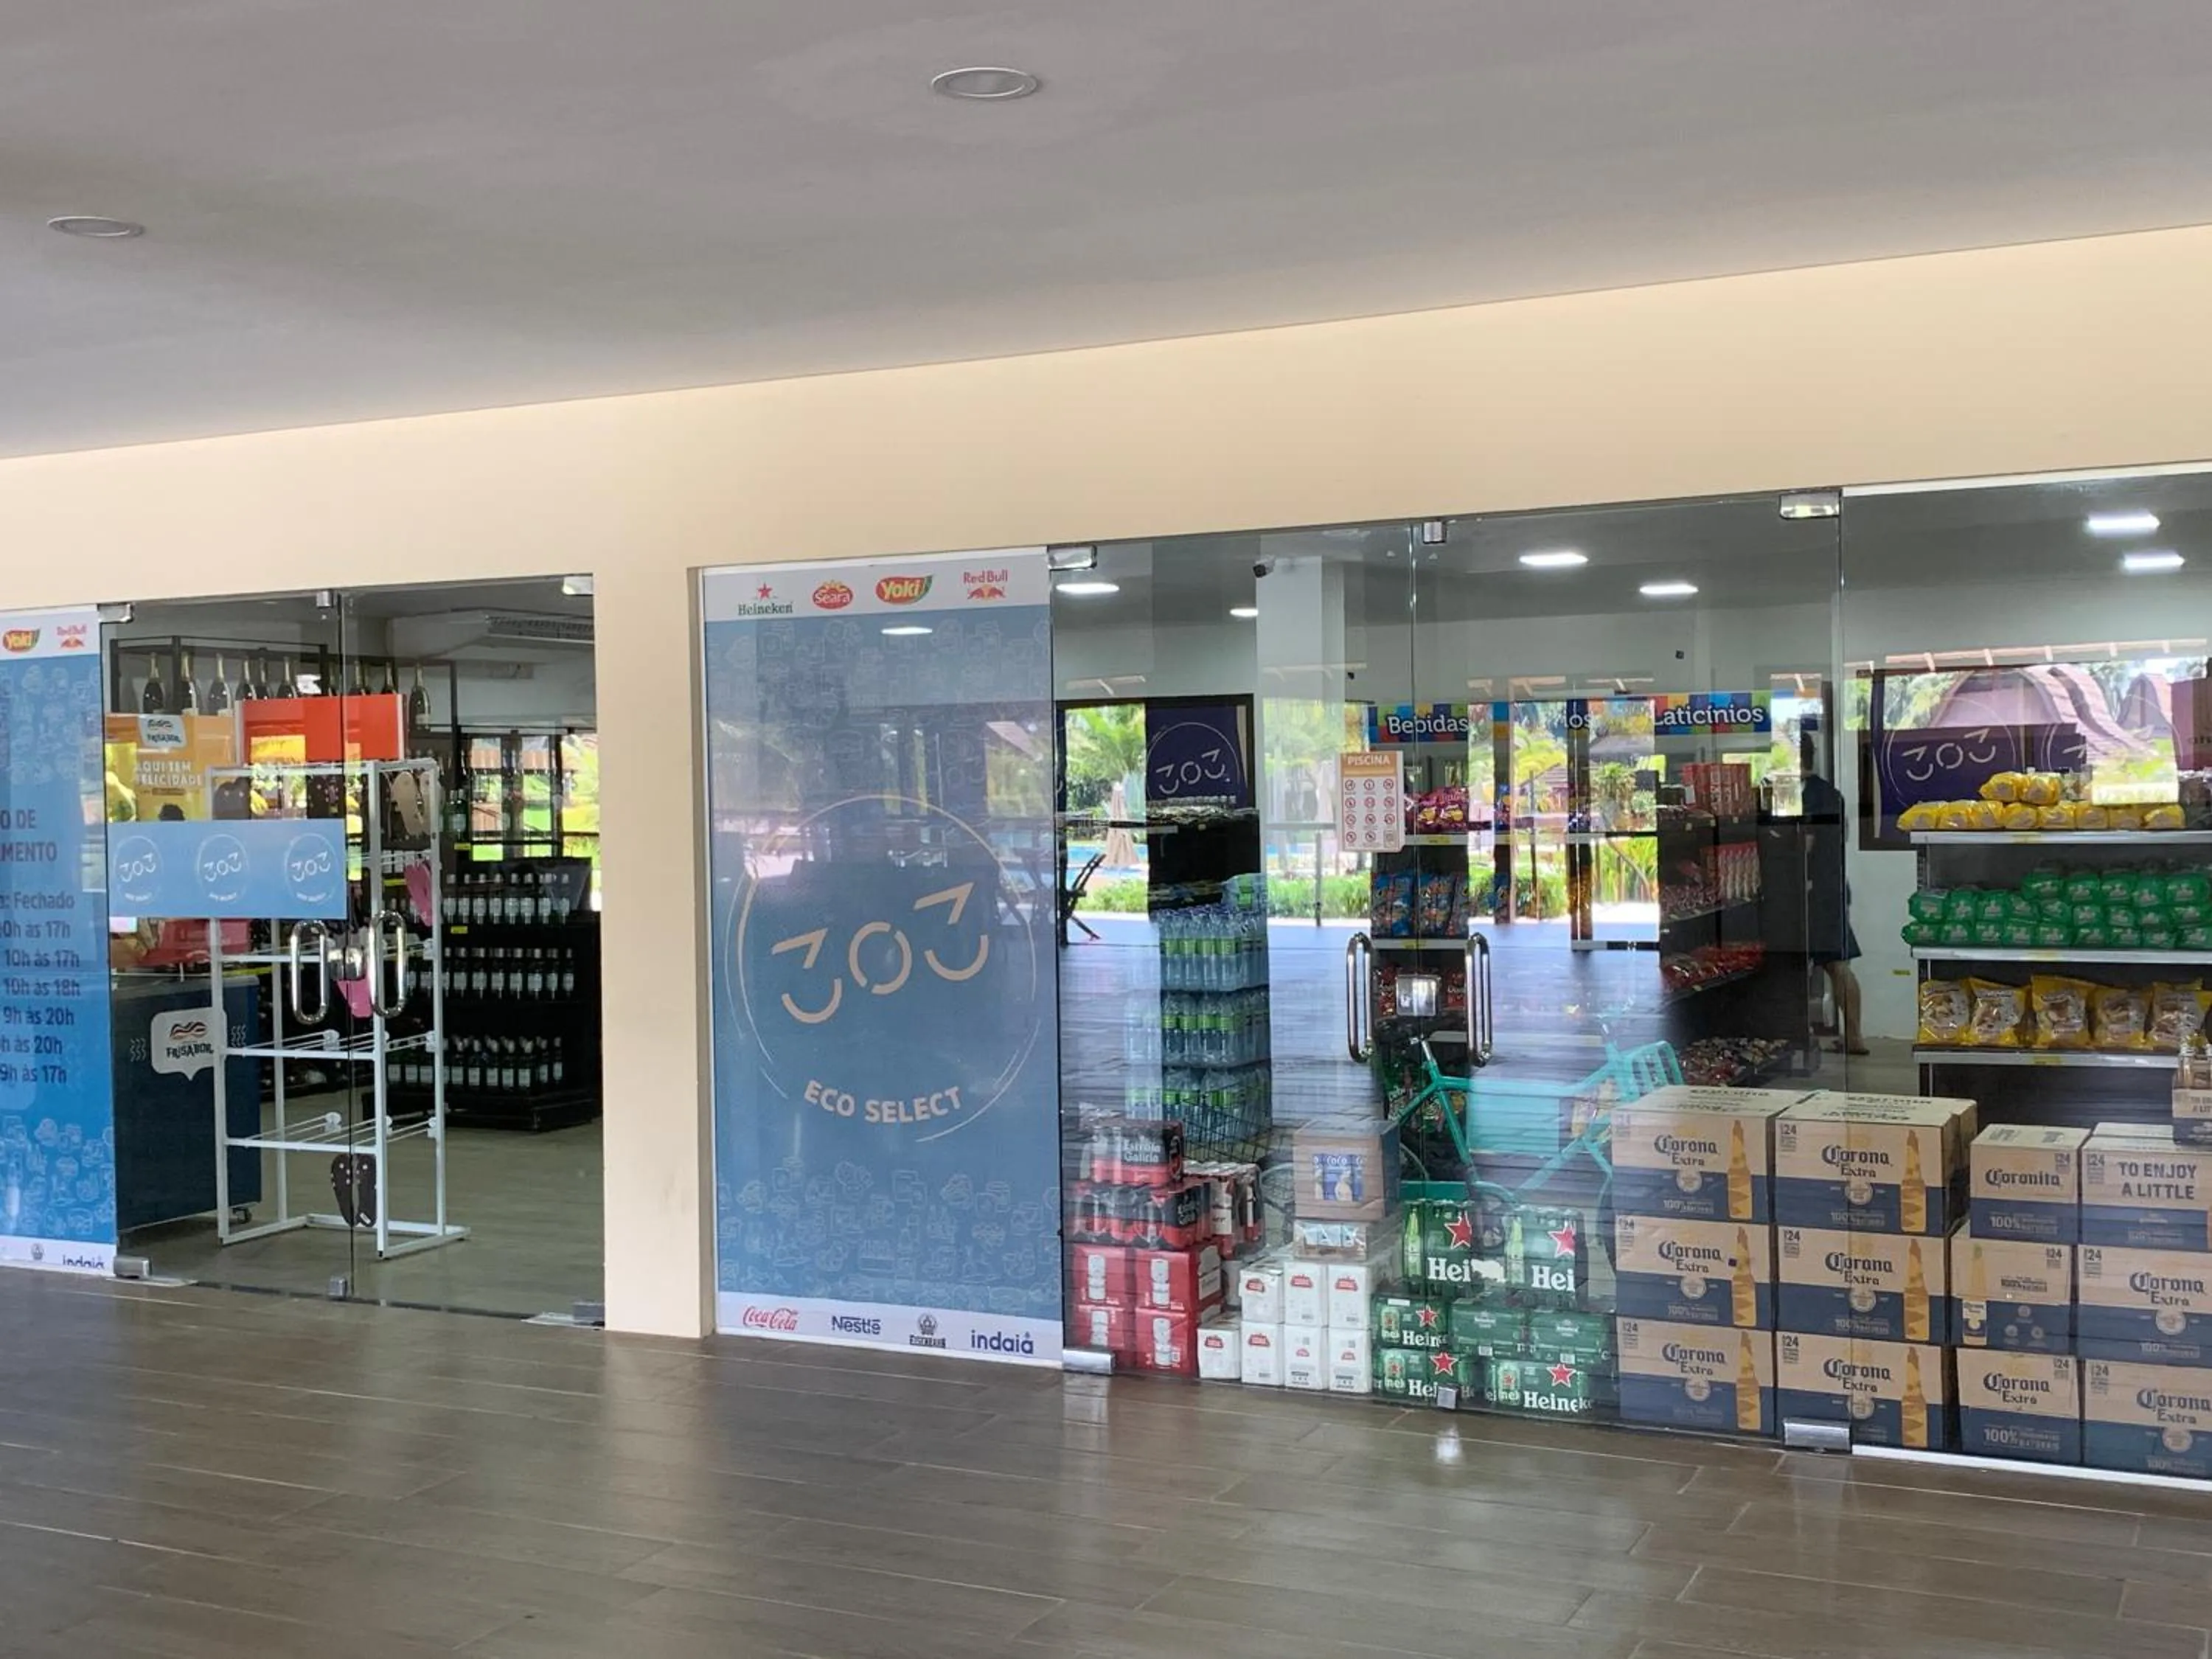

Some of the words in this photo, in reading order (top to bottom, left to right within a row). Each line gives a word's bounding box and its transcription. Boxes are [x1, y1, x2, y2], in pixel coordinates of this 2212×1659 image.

[964, 571, 985, 583] Red
[987, 569, 1008, 582] Bull
[815, 591, 850, 604] Seara
[881, 580, 921, 599] Yoki
[738, 601, 793, 616] Heineken
[1387, 714, 1469, 734] Bebidas
[1347, 754, 1391, 765] PISCINA
[16, 810, 36, 830] DE
[14, 891, 75, 909] Fechado
[46, 921, 71, 938] 17h
[5, 949, 30, 967] 10h
[55, 949, 80, 967] 17h
[3, 978, 29, 995] 10h
[55, 978, 80, 995] 18h
[3, 1006, 21, 1024] 9h
[46, 1007, 74, 1025] 20h
[34, 1035, 63, 1054] 20h
[41, 1065, 67, 1083] 17h
[804, 1079, 855, 1117] ECO
[865, 1086, 961, 1124] SELECT
[1654, 1134, 1718, 1157] Corona
[1672, 1152, 1705, 1166] Extra
[1821, 1144, 1890, 1166] Corona
[1841, 1164, 1876, 1178] Extra
[1985, 1168, 2060, 1188] Coronita
[2118, 1162, 2138, 1178] TO
[2143, 1163, 2197, 1179] ENJOY
[2121, 1182, 2132, 1197] A
[2138, 1183, 2194, 1200] LITTLE
[1788, 1231, 1800, 1242] 24
[1659, 1240, 1722, 1262] Corona
[1676, 1259, 1709, 1273] Extra
[1825, 1252, 1893, 1273] Corona
[1844, 1270, 1879, 1285] Extra
[2129, 1271, 2205, 1295] Corona
[2150, 1291, 2190, 1306] Extra
[1787, 1335, 1798, 1347] 24
[1662, 1343, 1726, 1364] Corona
[1680, 1361, 1713, 1375] Extra
[1823, 1357, 1891, 1380] Corona
[1843, 1378, 1877, 1393] Extra
[1983, 1372, 2050, 1395] Corona
[2003, 1390, 2037, 1405] Extra
[2137, 1388, 2212, 1411] Corona
[2157, 1408, 2197, 1424] Extra
